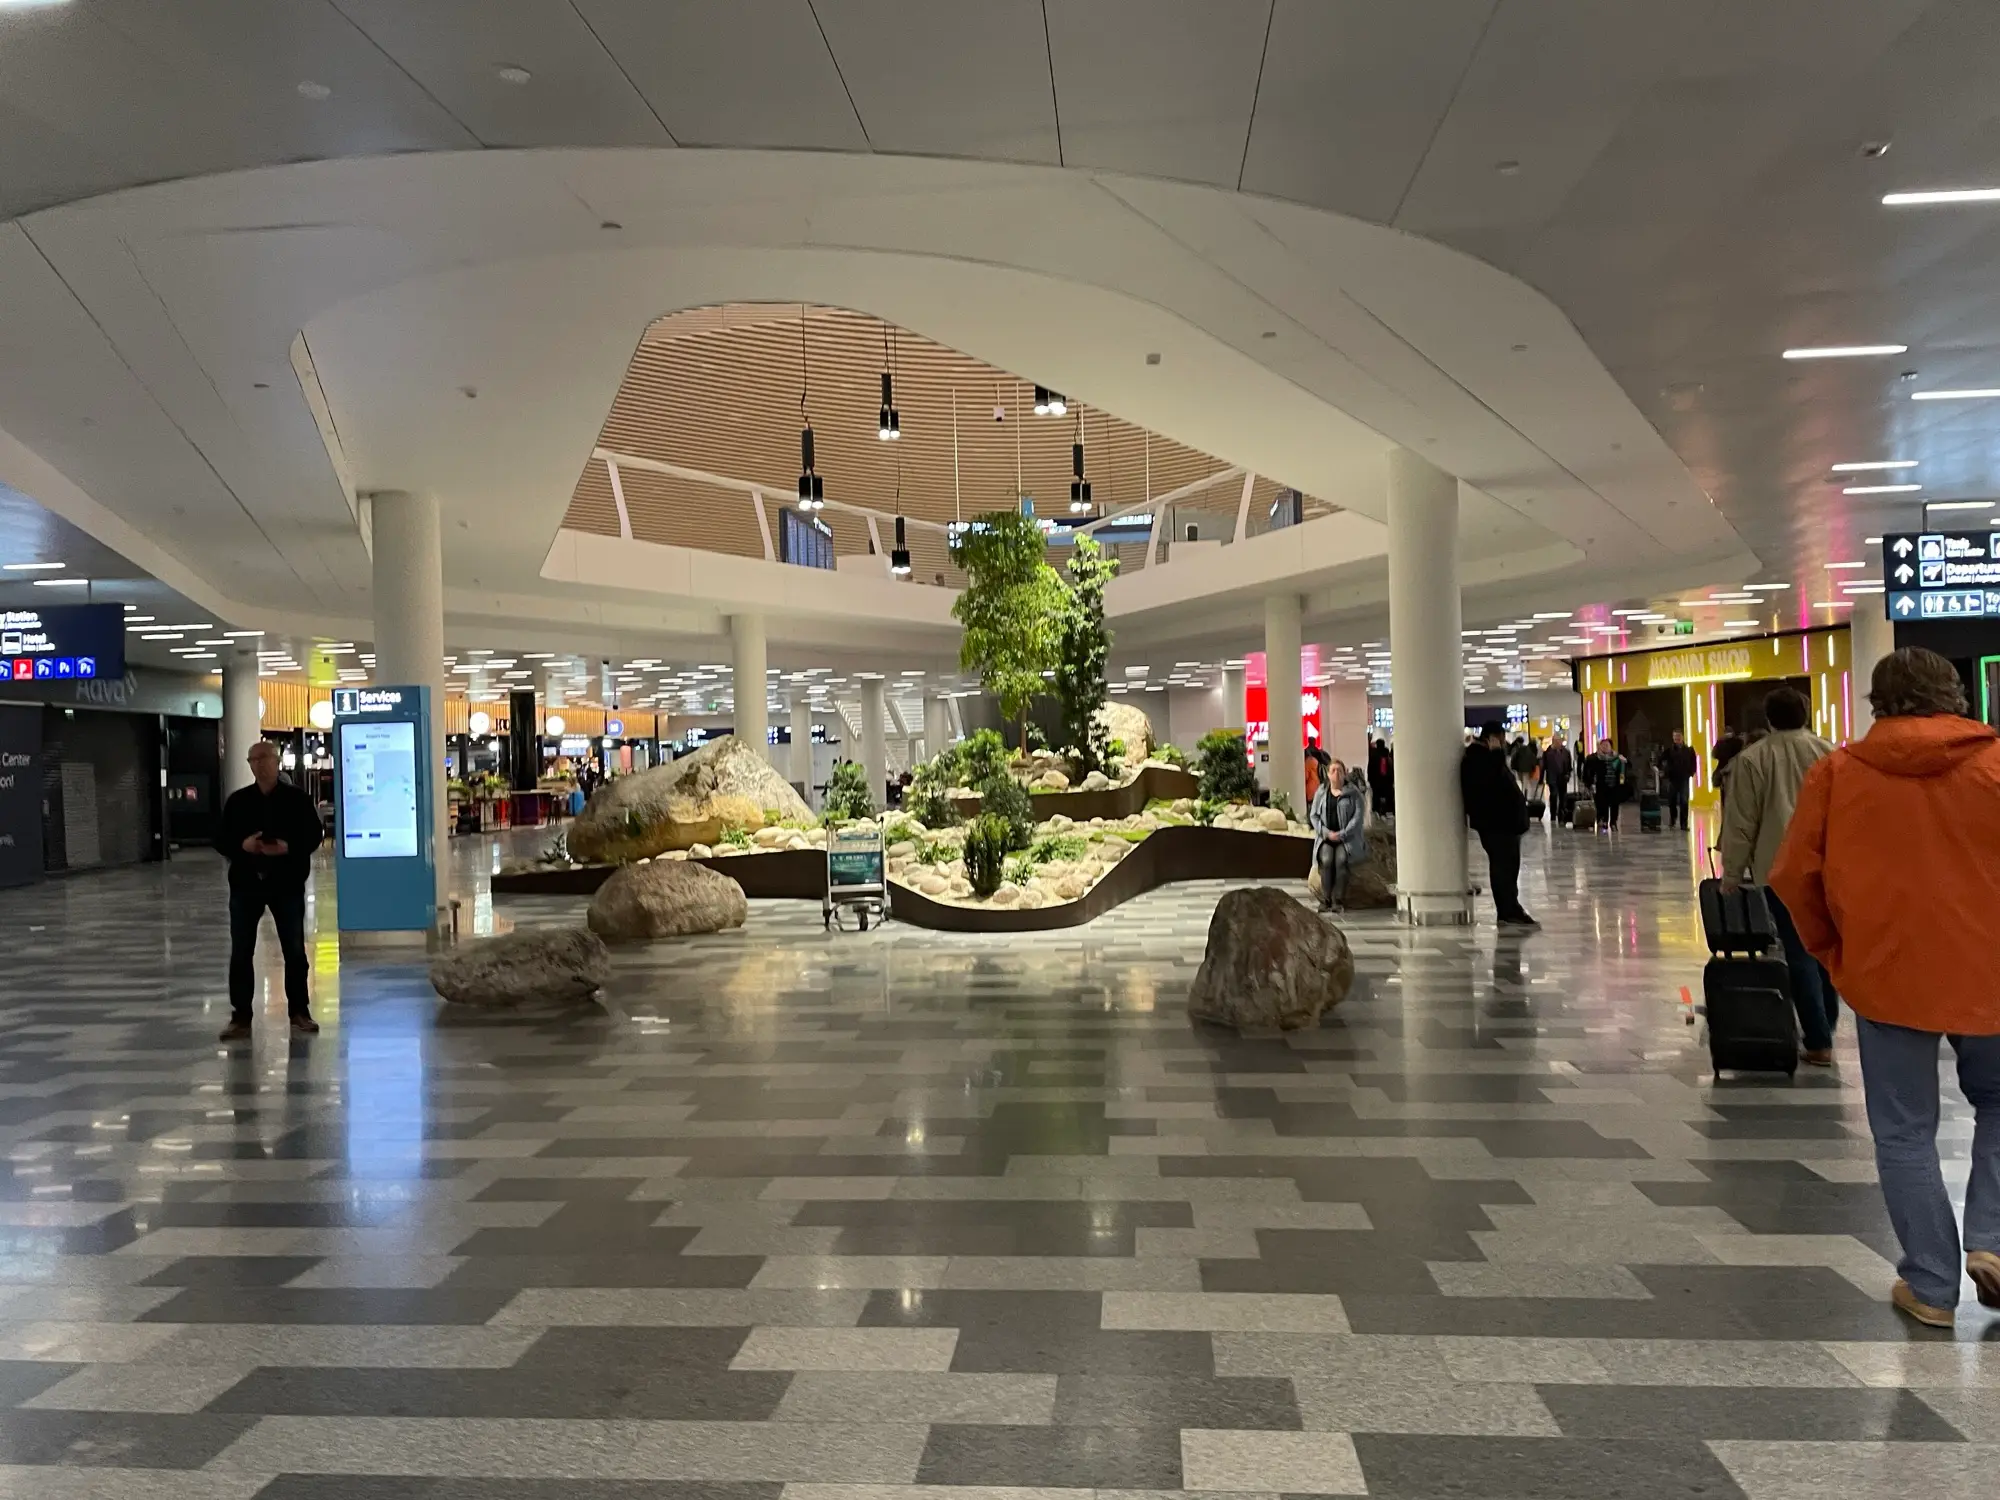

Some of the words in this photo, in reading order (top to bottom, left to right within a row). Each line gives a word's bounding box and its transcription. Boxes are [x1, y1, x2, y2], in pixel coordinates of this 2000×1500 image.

[1648, 652, 1705, 680] MOOMIN
[1708, 647, 1750, 675] SHOP
[360, 690, 402, 704] Services
